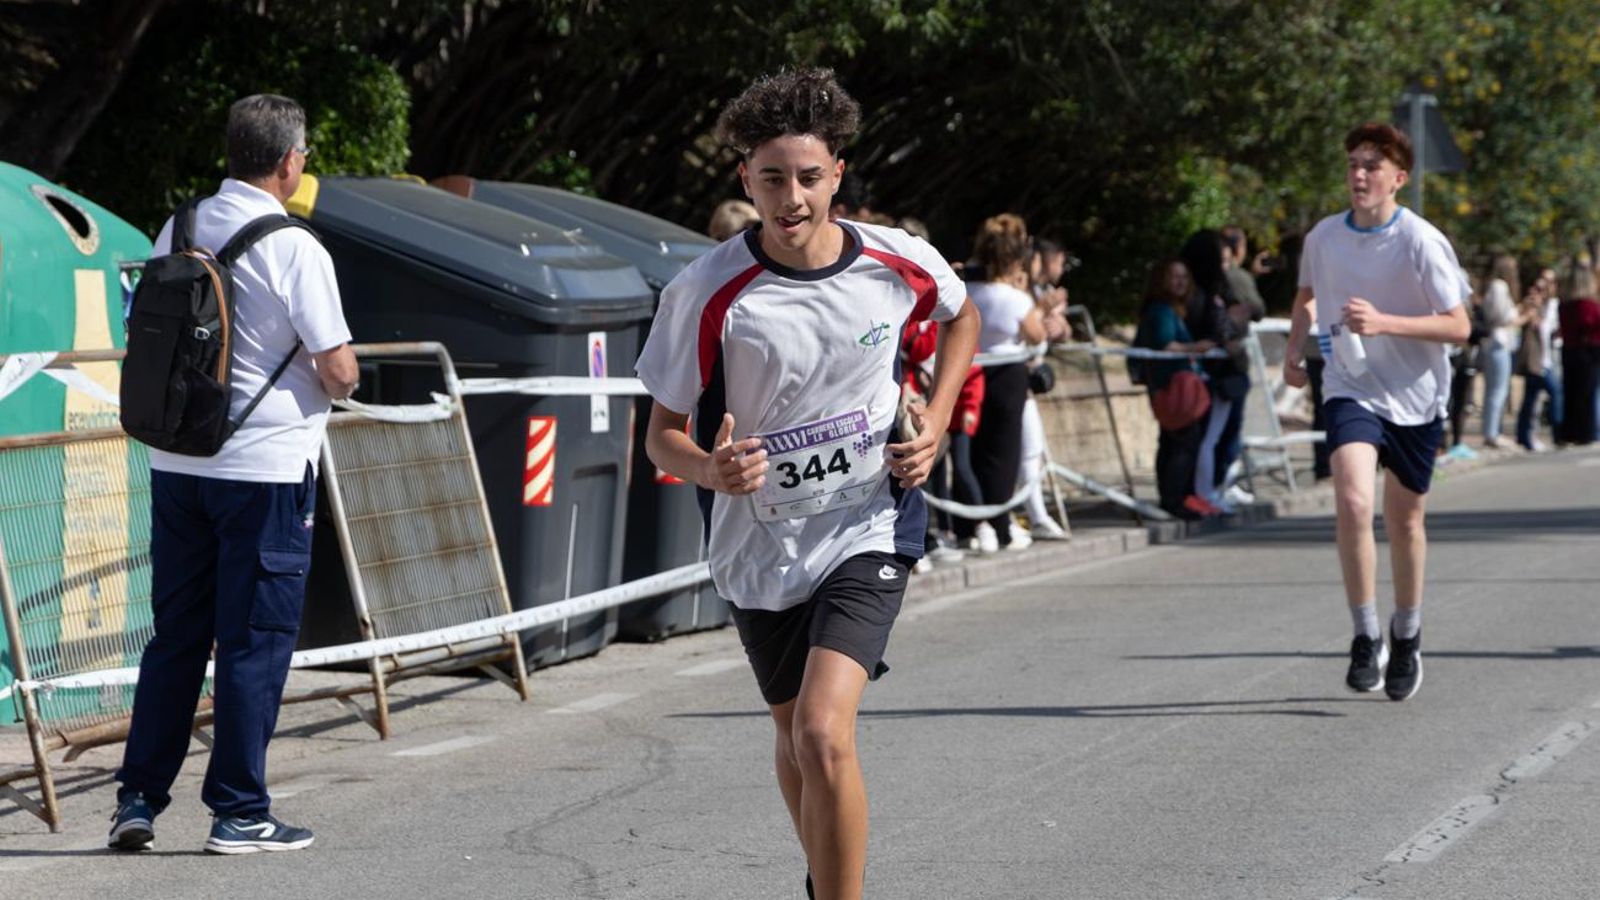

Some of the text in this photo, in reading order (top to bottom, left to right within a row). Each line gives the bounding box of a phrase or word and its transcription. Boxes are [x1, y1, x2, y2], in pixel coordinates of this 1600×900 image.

[808, 413, 863, 435] CARRERA ESCOLAR
[814, 423, 858, 443] LA GLORIA
[766, 430, 808, 454] XXXVI
[776, 447, 851, 489] 344
